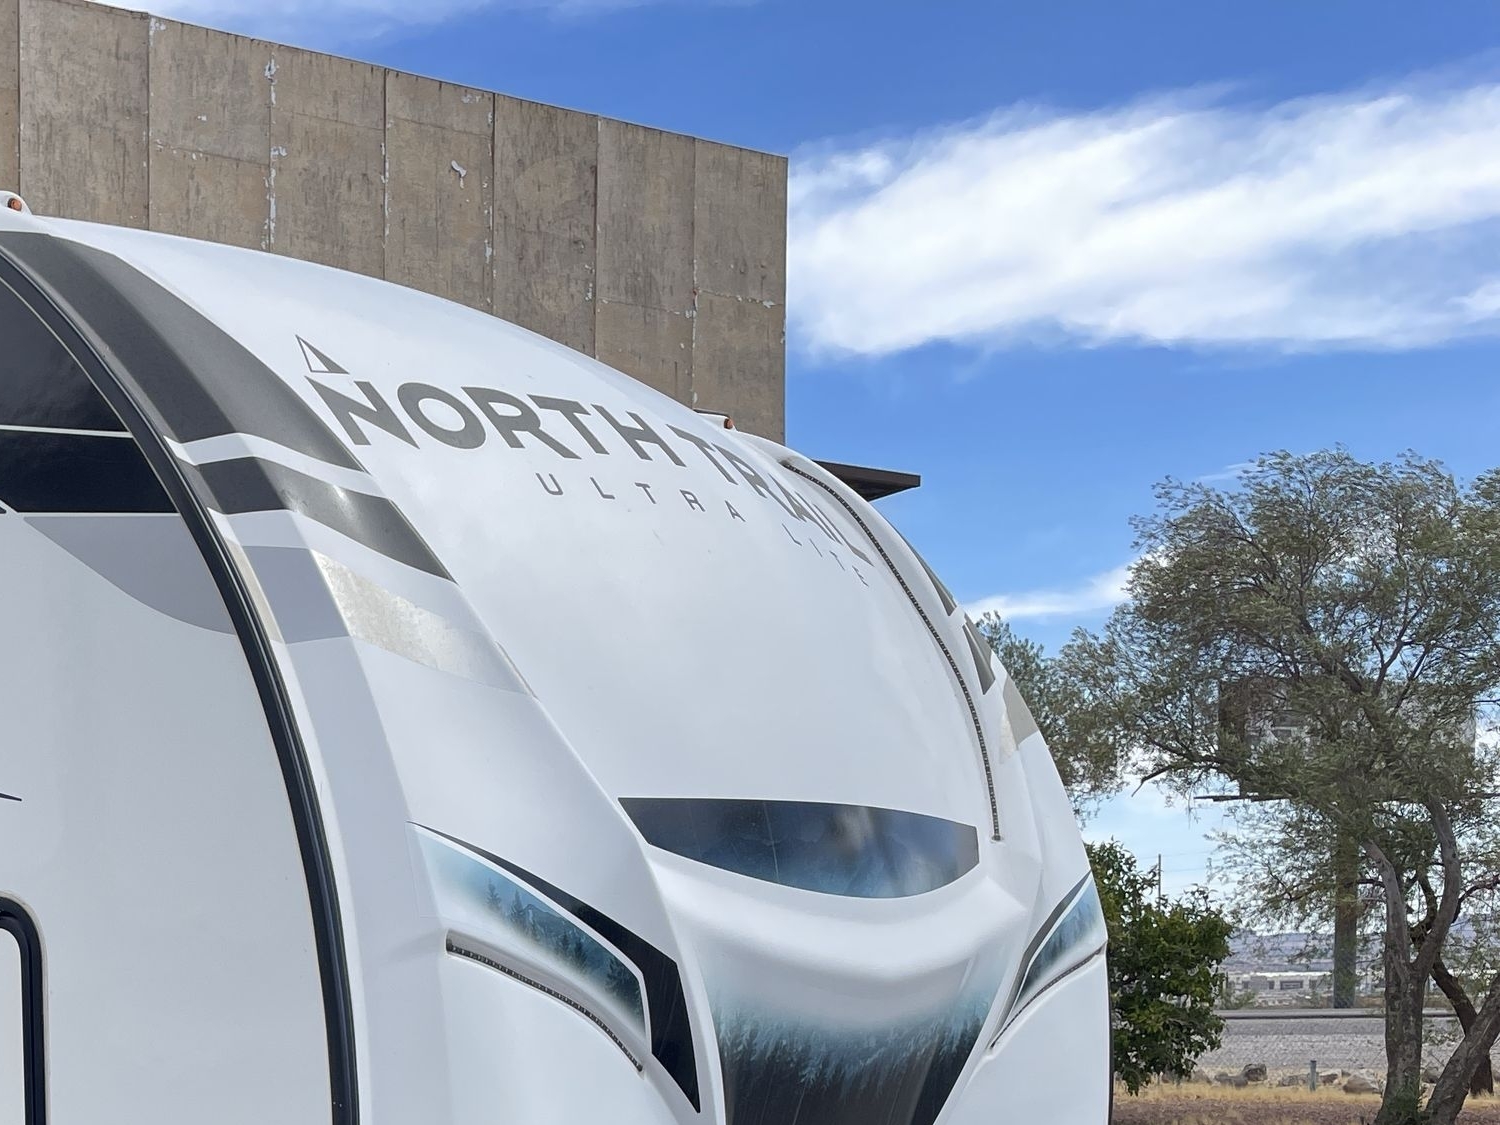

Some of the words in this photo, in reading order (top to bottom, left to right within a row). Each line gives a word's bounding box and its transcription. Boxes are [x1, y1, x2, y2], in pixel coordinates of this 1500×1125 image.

[305, 375, 687, 467] NORTH
[666, 423, 875, 568] TRAIL
[535, 471, 746, 523] ULTRA
[781, 522, 870, 588] LITE
